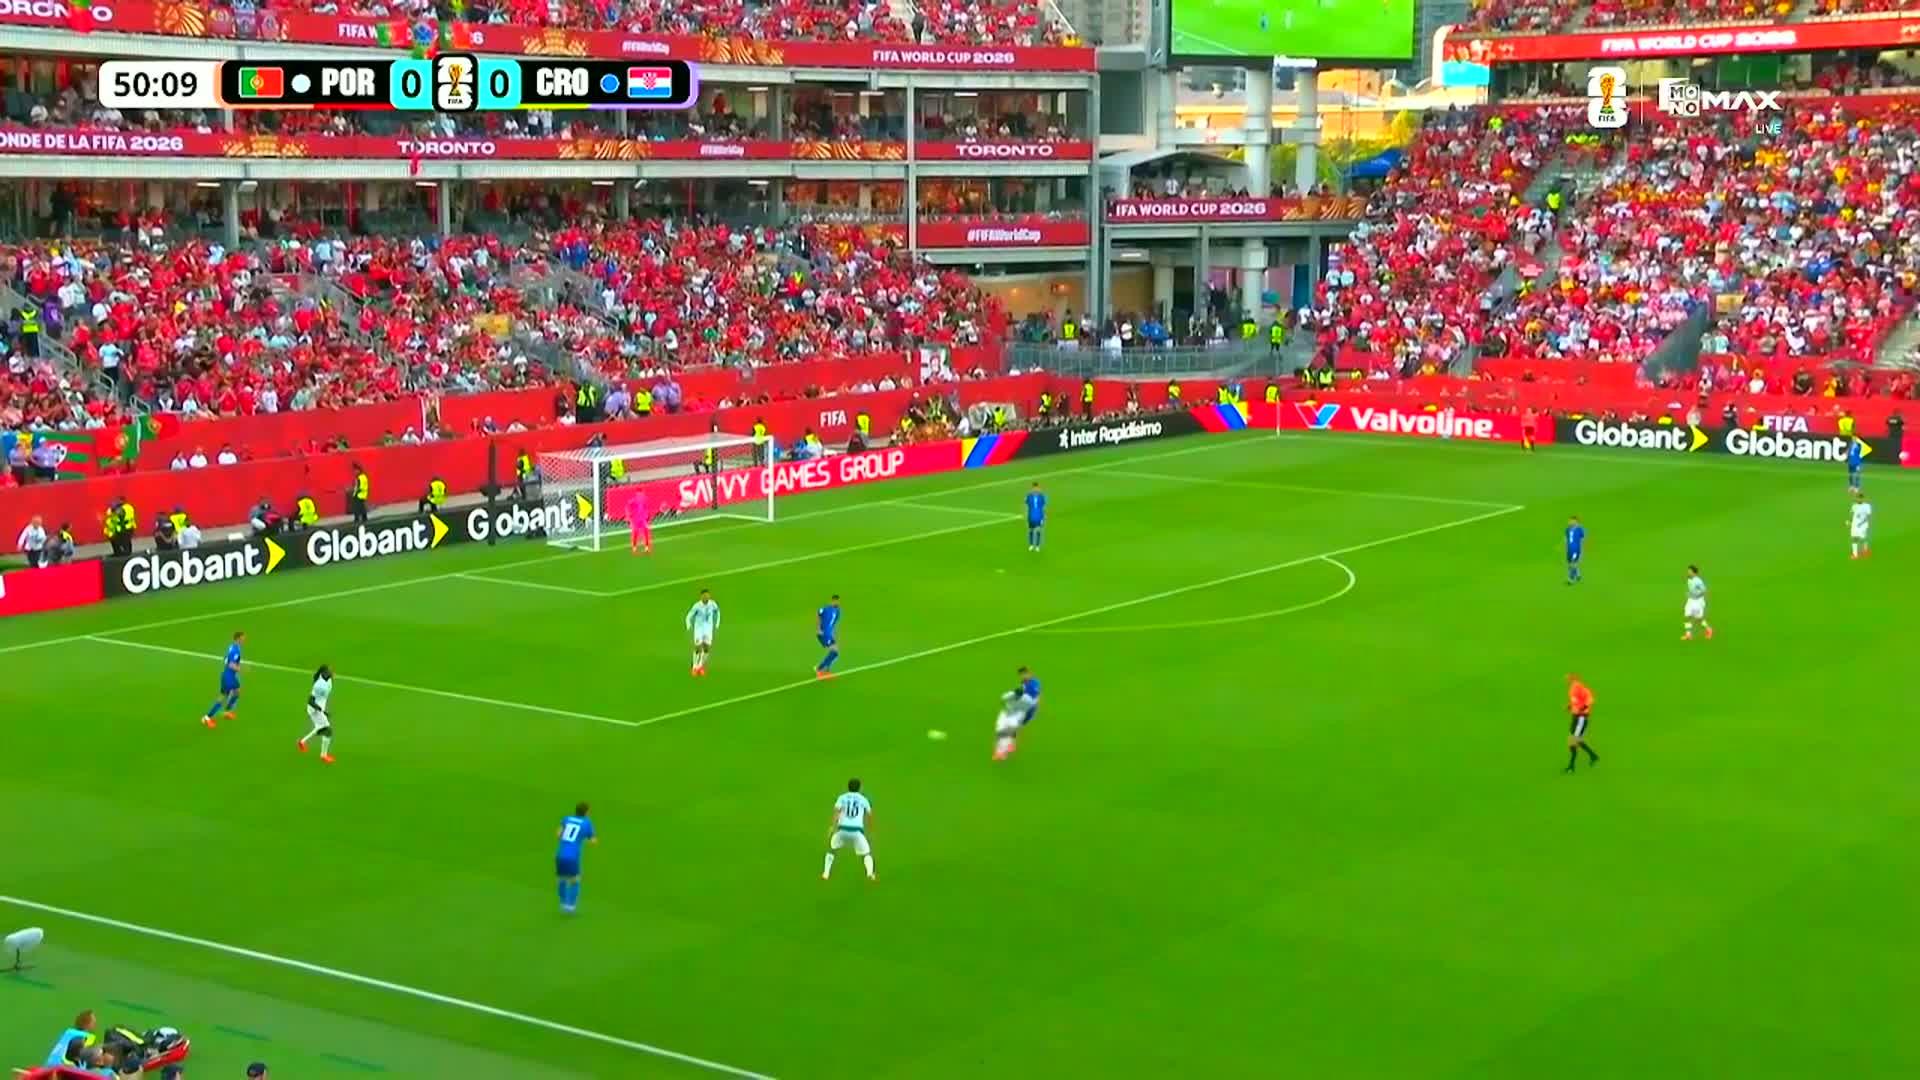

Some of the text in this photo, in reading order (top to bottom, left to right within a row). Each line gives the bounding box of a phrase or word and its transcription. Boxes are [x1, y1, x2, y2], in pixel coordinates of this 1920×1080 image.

[873, 50, 1015, 64] FIFA WORLD CUP 2026
[45, 133, 66, 149] DE
[69, 134, 91, 150] LA
[92, 135, 128, 150] FIFA
[130, 136, 184, 151] 2026
[397, 141, 496, 155] TORONTO
[956, 145, 1053, 156] TORONTO
[1139, 203, 1188, 217] WORLD
[1191, 203, 1217, 215] CUP
[1219, 202, 1266, 215] 2026
[820, 411, 847, 427] FIFA
[1350, 406, 1493, 438] Valvoline
[1762, 415, 1808, 433] FIFA
[1070, 428, 1098, 447] Inter
[1575, 420, 1688, 451] Globant
[1725, 428, 1848, 462] Globant
[761, 462, 830, 495] GAMES
[840, 450, 905, 482] GROUP
[467, 498, 575, 541] Gobant
[307, 514, 429, 566] Globant
[122, 543, 264, 595] Globant
[562, 822, 581, 842] 10
